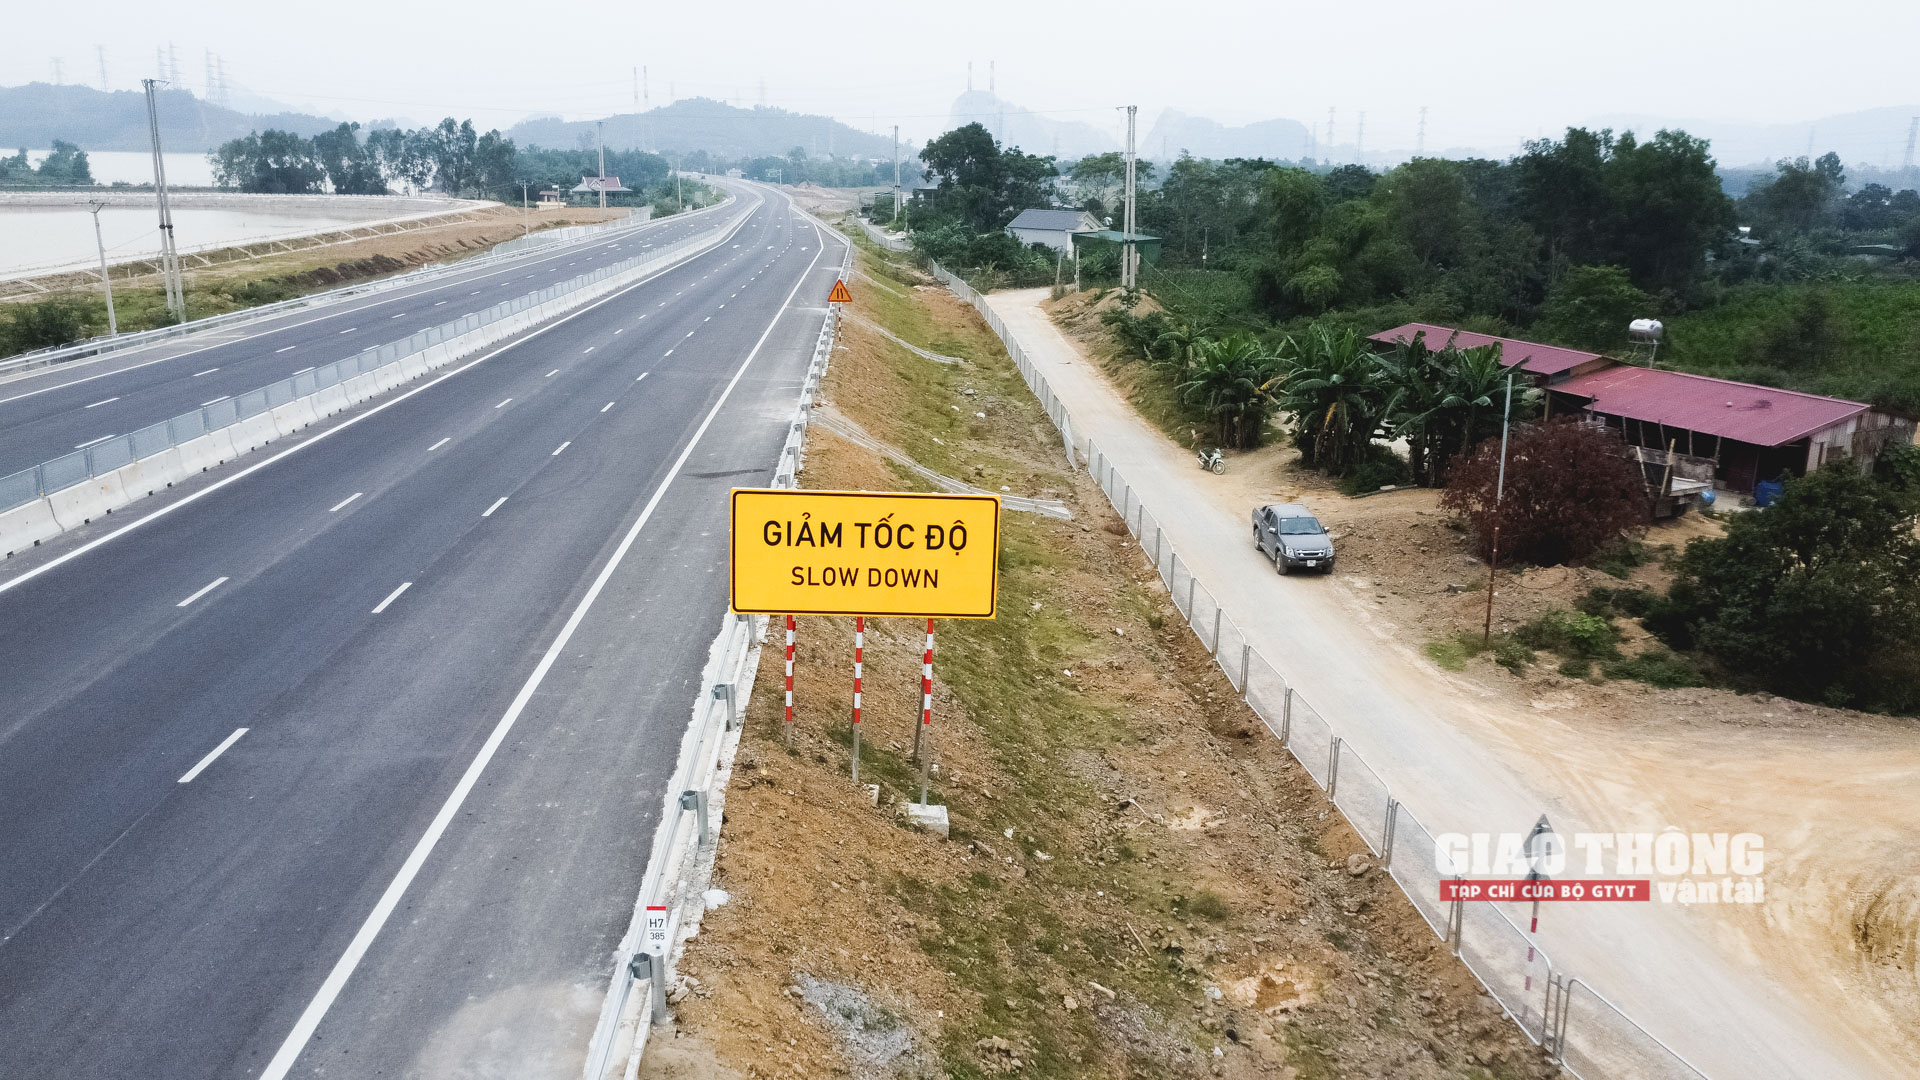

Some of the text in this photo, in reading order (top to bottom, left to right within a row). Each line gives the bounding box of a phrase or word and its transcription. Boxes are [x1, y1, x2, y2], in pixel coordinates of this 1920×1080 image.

[763, 512, 968, 556] GIẢM TỐC ĐỘ
[791, 566, 939, 588] SLOW DOWN
[649, 918, 664, 928] H7
[650, 932, 665, 941] 385
